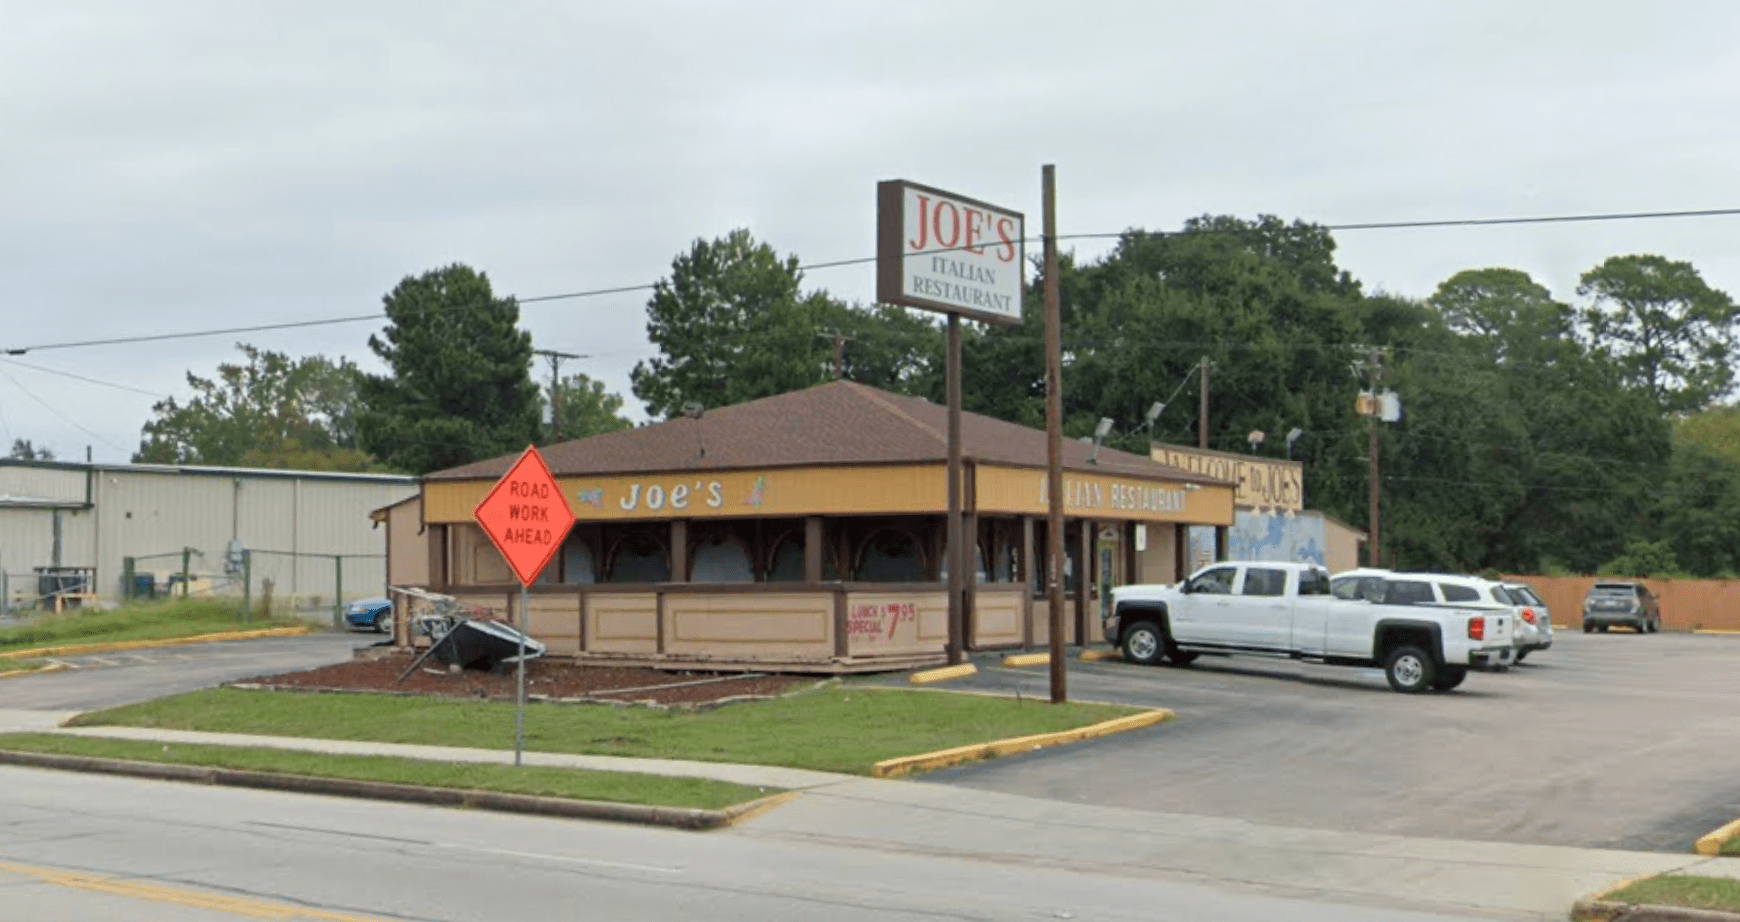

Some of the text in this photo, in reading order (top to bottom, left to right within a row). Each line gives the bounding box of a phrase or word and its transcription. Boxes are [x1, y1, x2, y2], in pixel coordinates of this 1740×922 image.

[909, 195, 1015, 262] JOE'S
[932, 256, 996, 285] ITALIAN
[913, 275, 1012, 312] RESTAURANT
[509, 480, 549, 499] ROAD
[1039, 477, 1186, 512] ILIAN RESTAURANT
[509, 504, 549, 522] WORK
[503, 527, 552, 545] AHEAD
